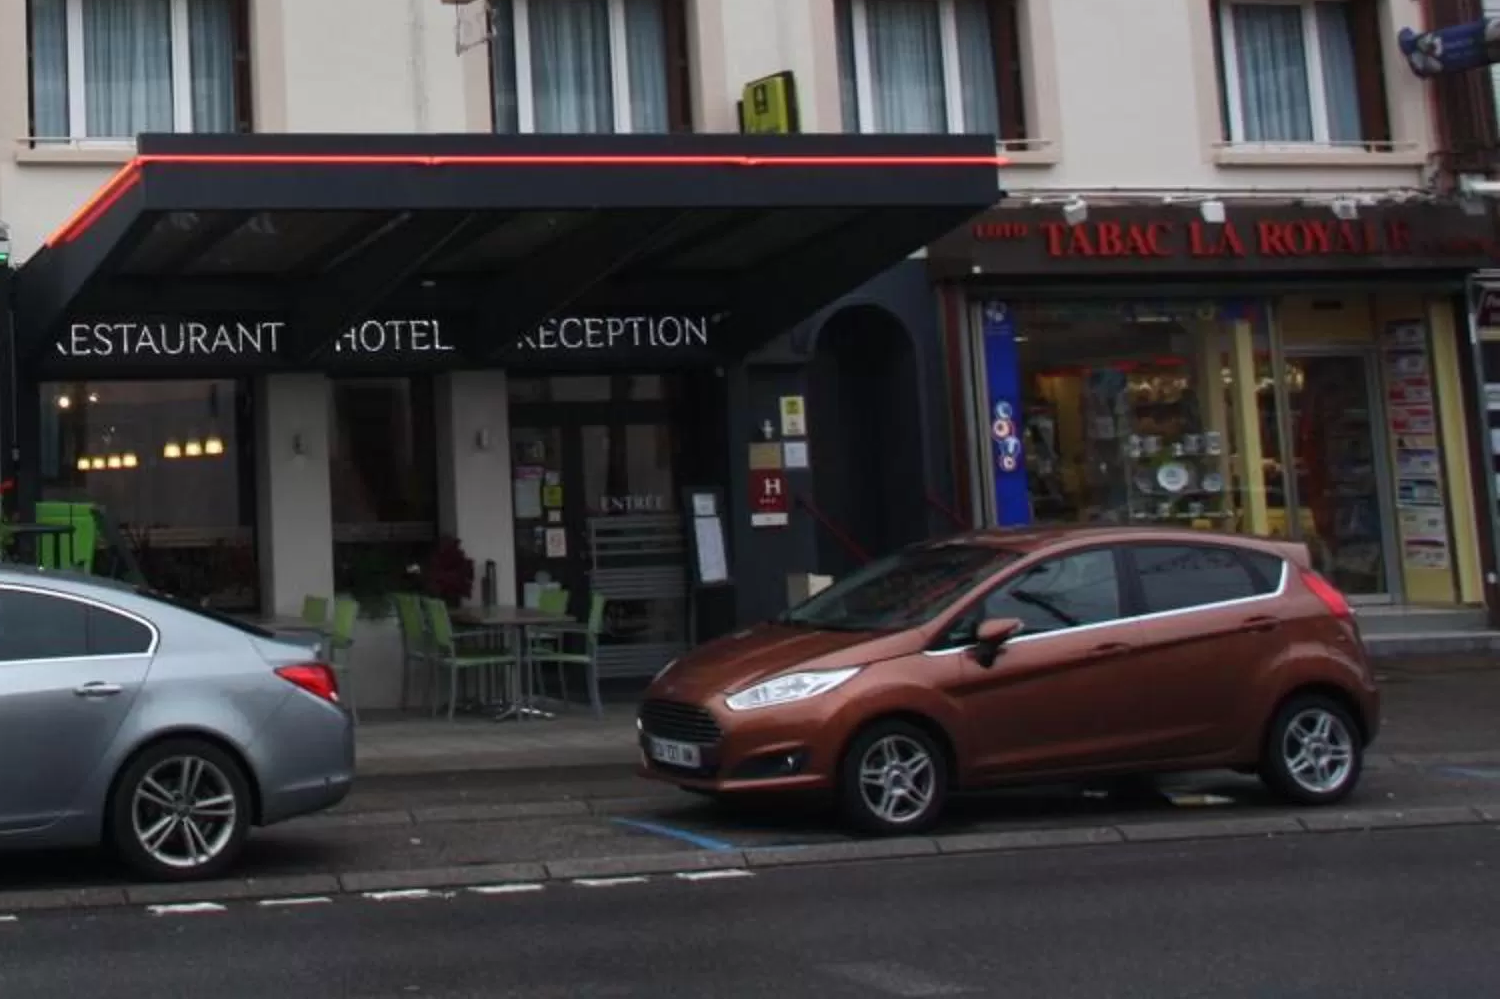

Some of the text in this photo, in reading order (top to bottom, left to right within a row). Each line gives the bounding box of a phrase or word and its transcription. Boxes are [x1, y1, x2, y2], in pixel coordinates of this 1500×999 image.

[1040, 220, 1176, 259] TABAC
[1190, 220, 1246, 258] LA
[1257, 220, 1412, 256] ROYALE
[764, 478, 781, 496] H
